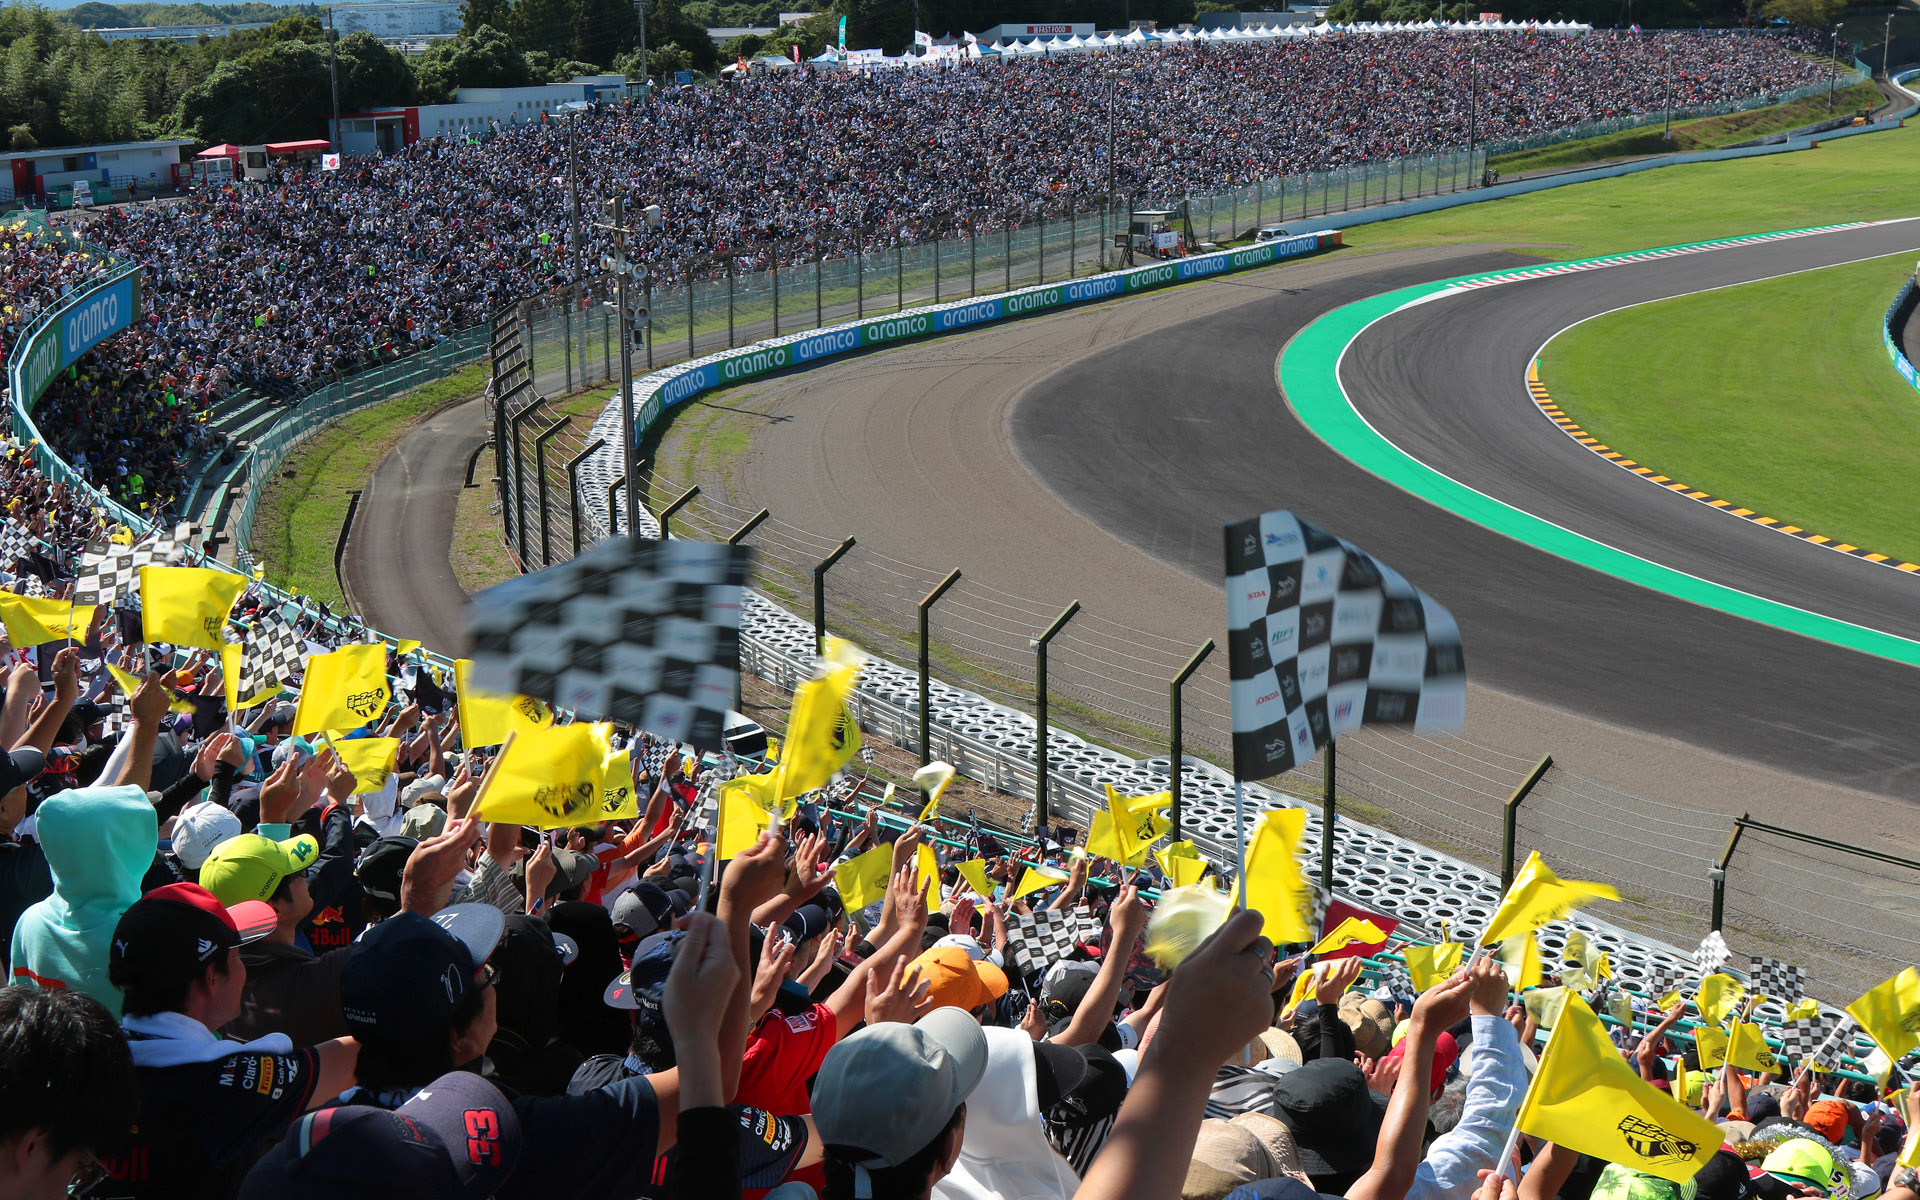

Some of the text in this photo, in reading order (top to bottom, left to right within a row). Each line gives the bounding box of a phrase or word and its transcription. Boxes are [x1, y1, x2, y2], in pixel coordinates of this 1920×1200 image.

[1234, 247, 1272, 267] aramco
[1280, 238, 1314, 255] aramco
[1130, 266, 1173, 288] aramco
[1183, 256, 1225, 276] aramco
[1008, 289, 1058, 312] aramco
[1070, 278, 1117, 299] aramco
[69, 293, 118, 353] aramco
[943, 303, 995, 327] aramco
[868, 317, 927, 341] aramco
[800, 331, 855, 359] aramco
[28, 333, 57, 404] aramco
[725, 349, 786, 378] aramco
[664, 370, 705, 404] aramco
[640, 395, 660, 432] aramco
[1247, 590, 1266, 600] NDA
[290, 840, 312, 862] 14
[259, 871, 277, 897] aramco
[320, 928, 351, 945] Bull
[242, 1057, 257, 1090] Claro
[464, 1108, 500, 1167] 33
